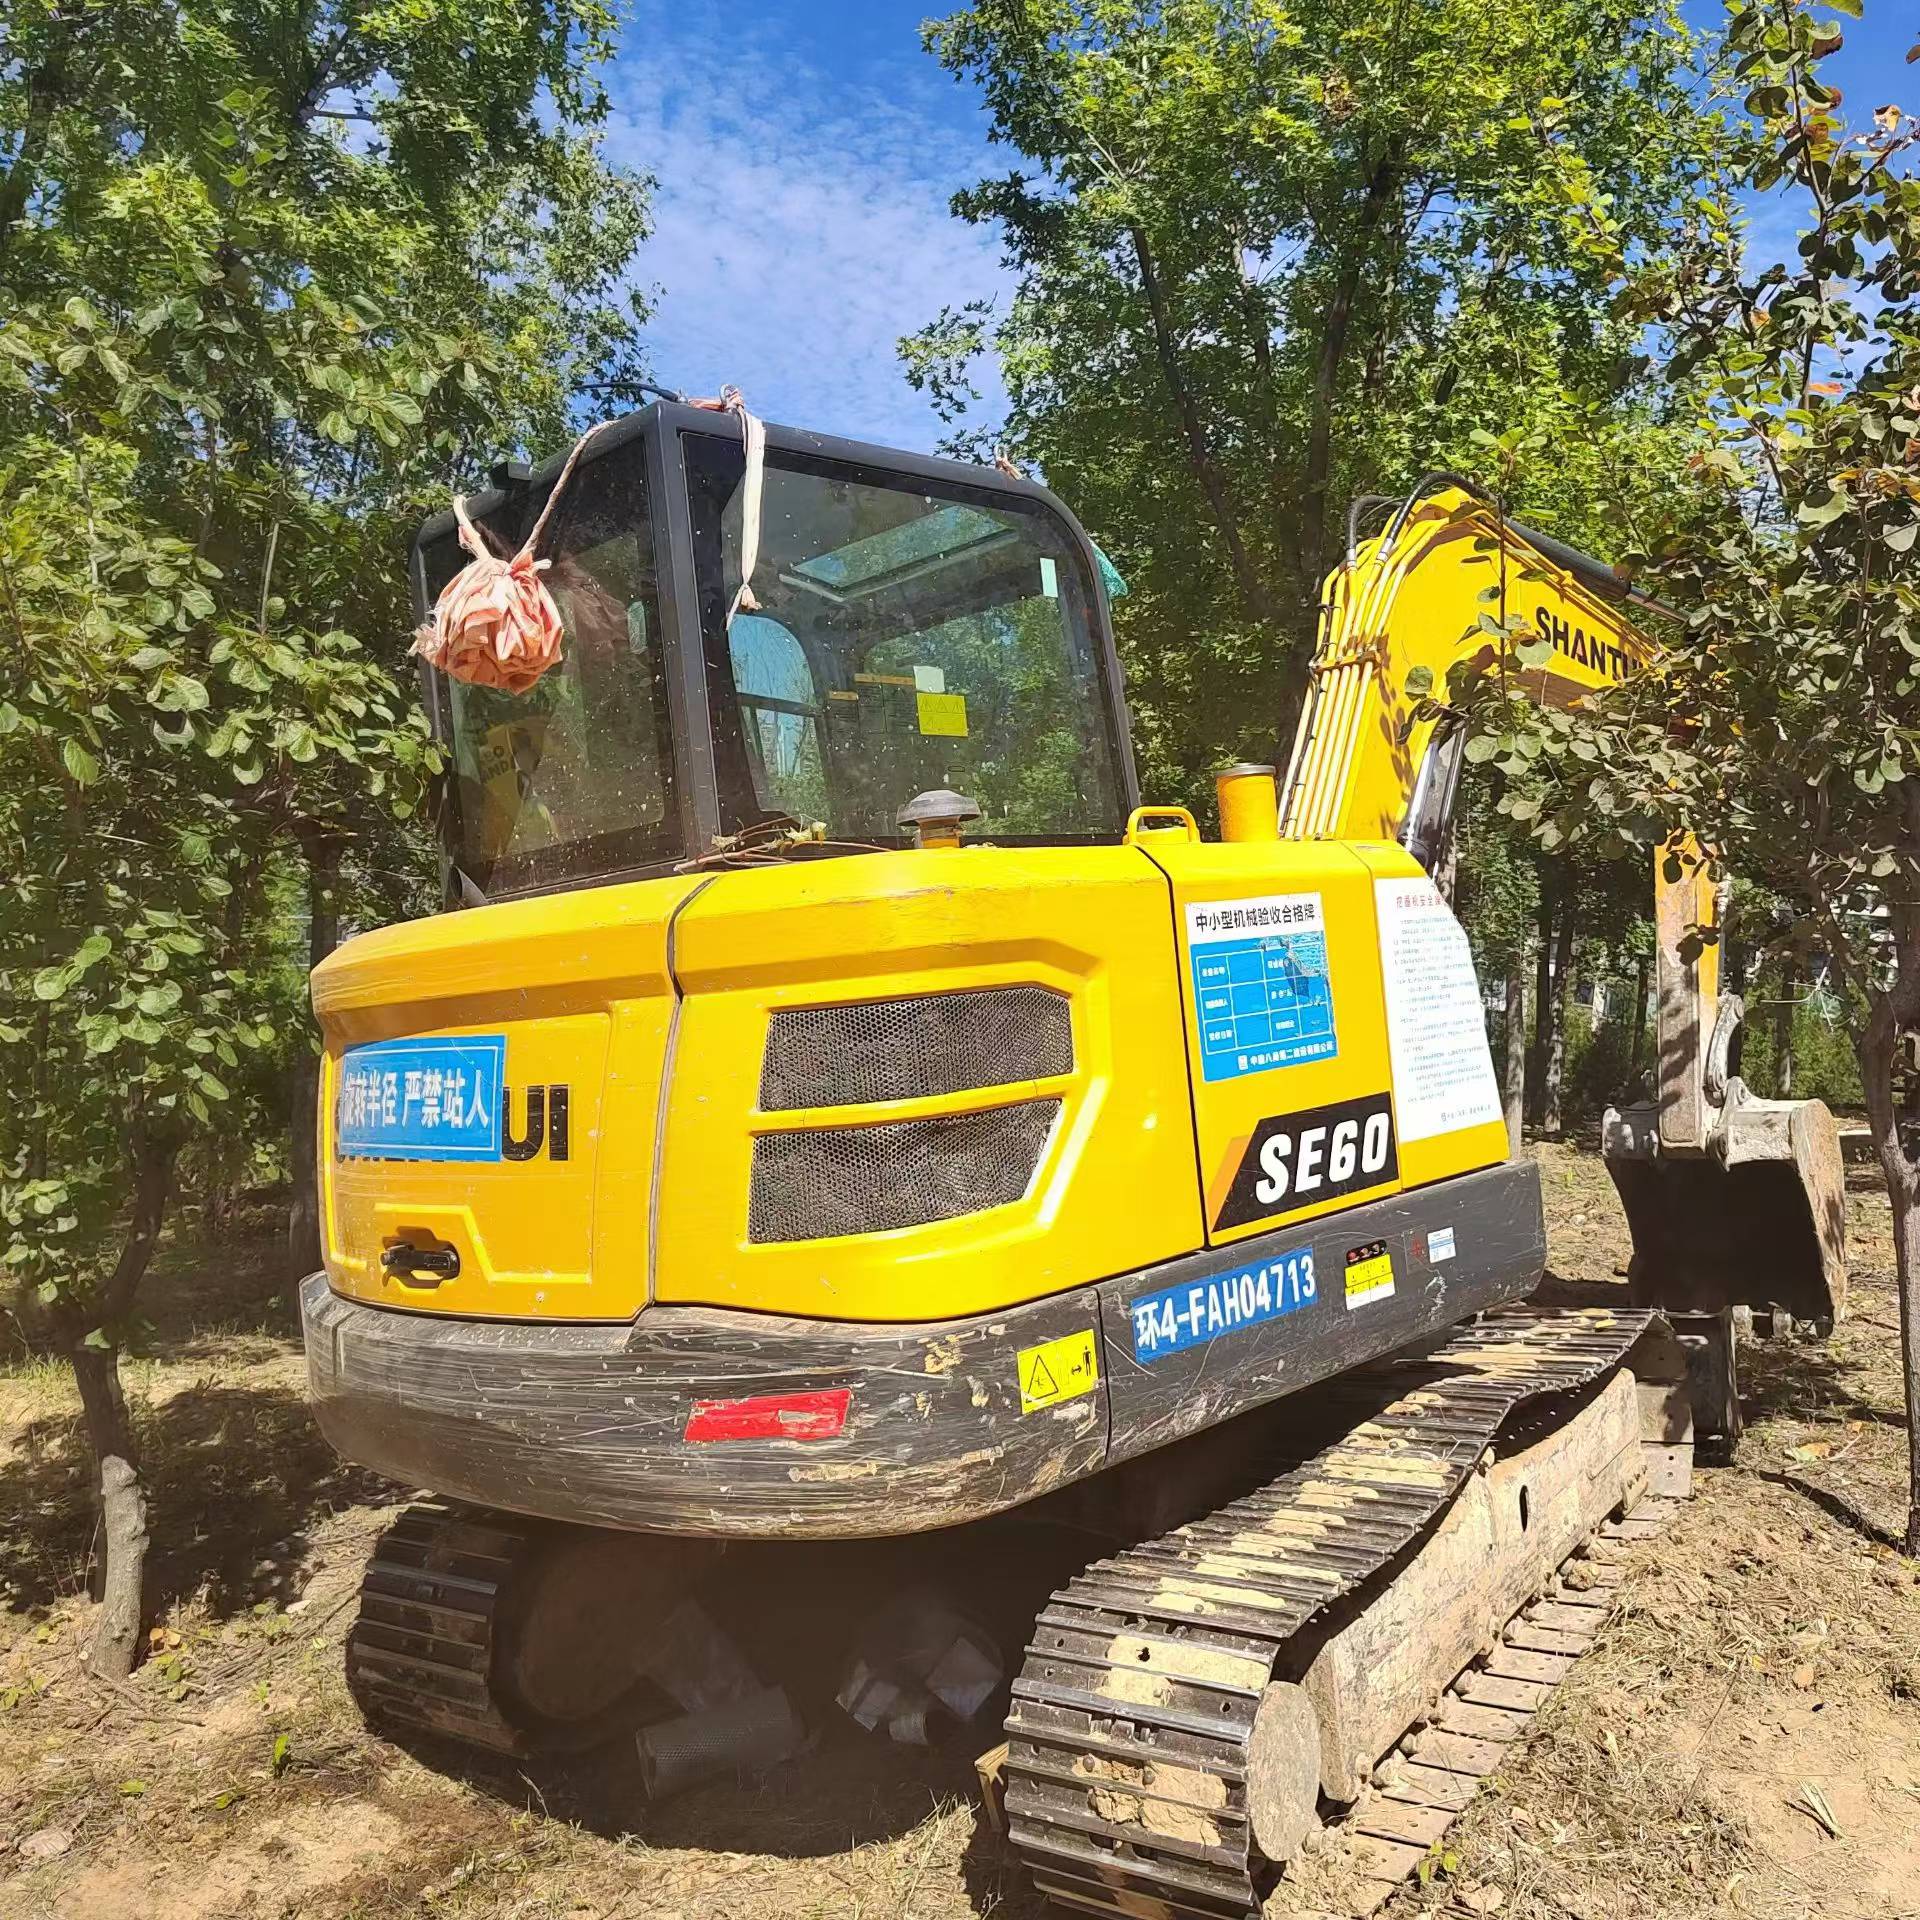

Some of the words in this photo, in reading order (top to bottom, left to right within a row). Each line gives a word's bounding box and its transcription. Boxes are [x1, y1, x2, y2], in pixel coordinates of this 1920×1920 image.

[1196, 904, 1315, 932] 中小型机械验收合格牌
[343, 1069, 398, 1128] 旋转半径
[402, 1067, 489, 1128] 严禁站人
[1256, 1112, 1389, 1204] SE60
[1135, 1255, 1316, 1350] 环4-FAH04713
